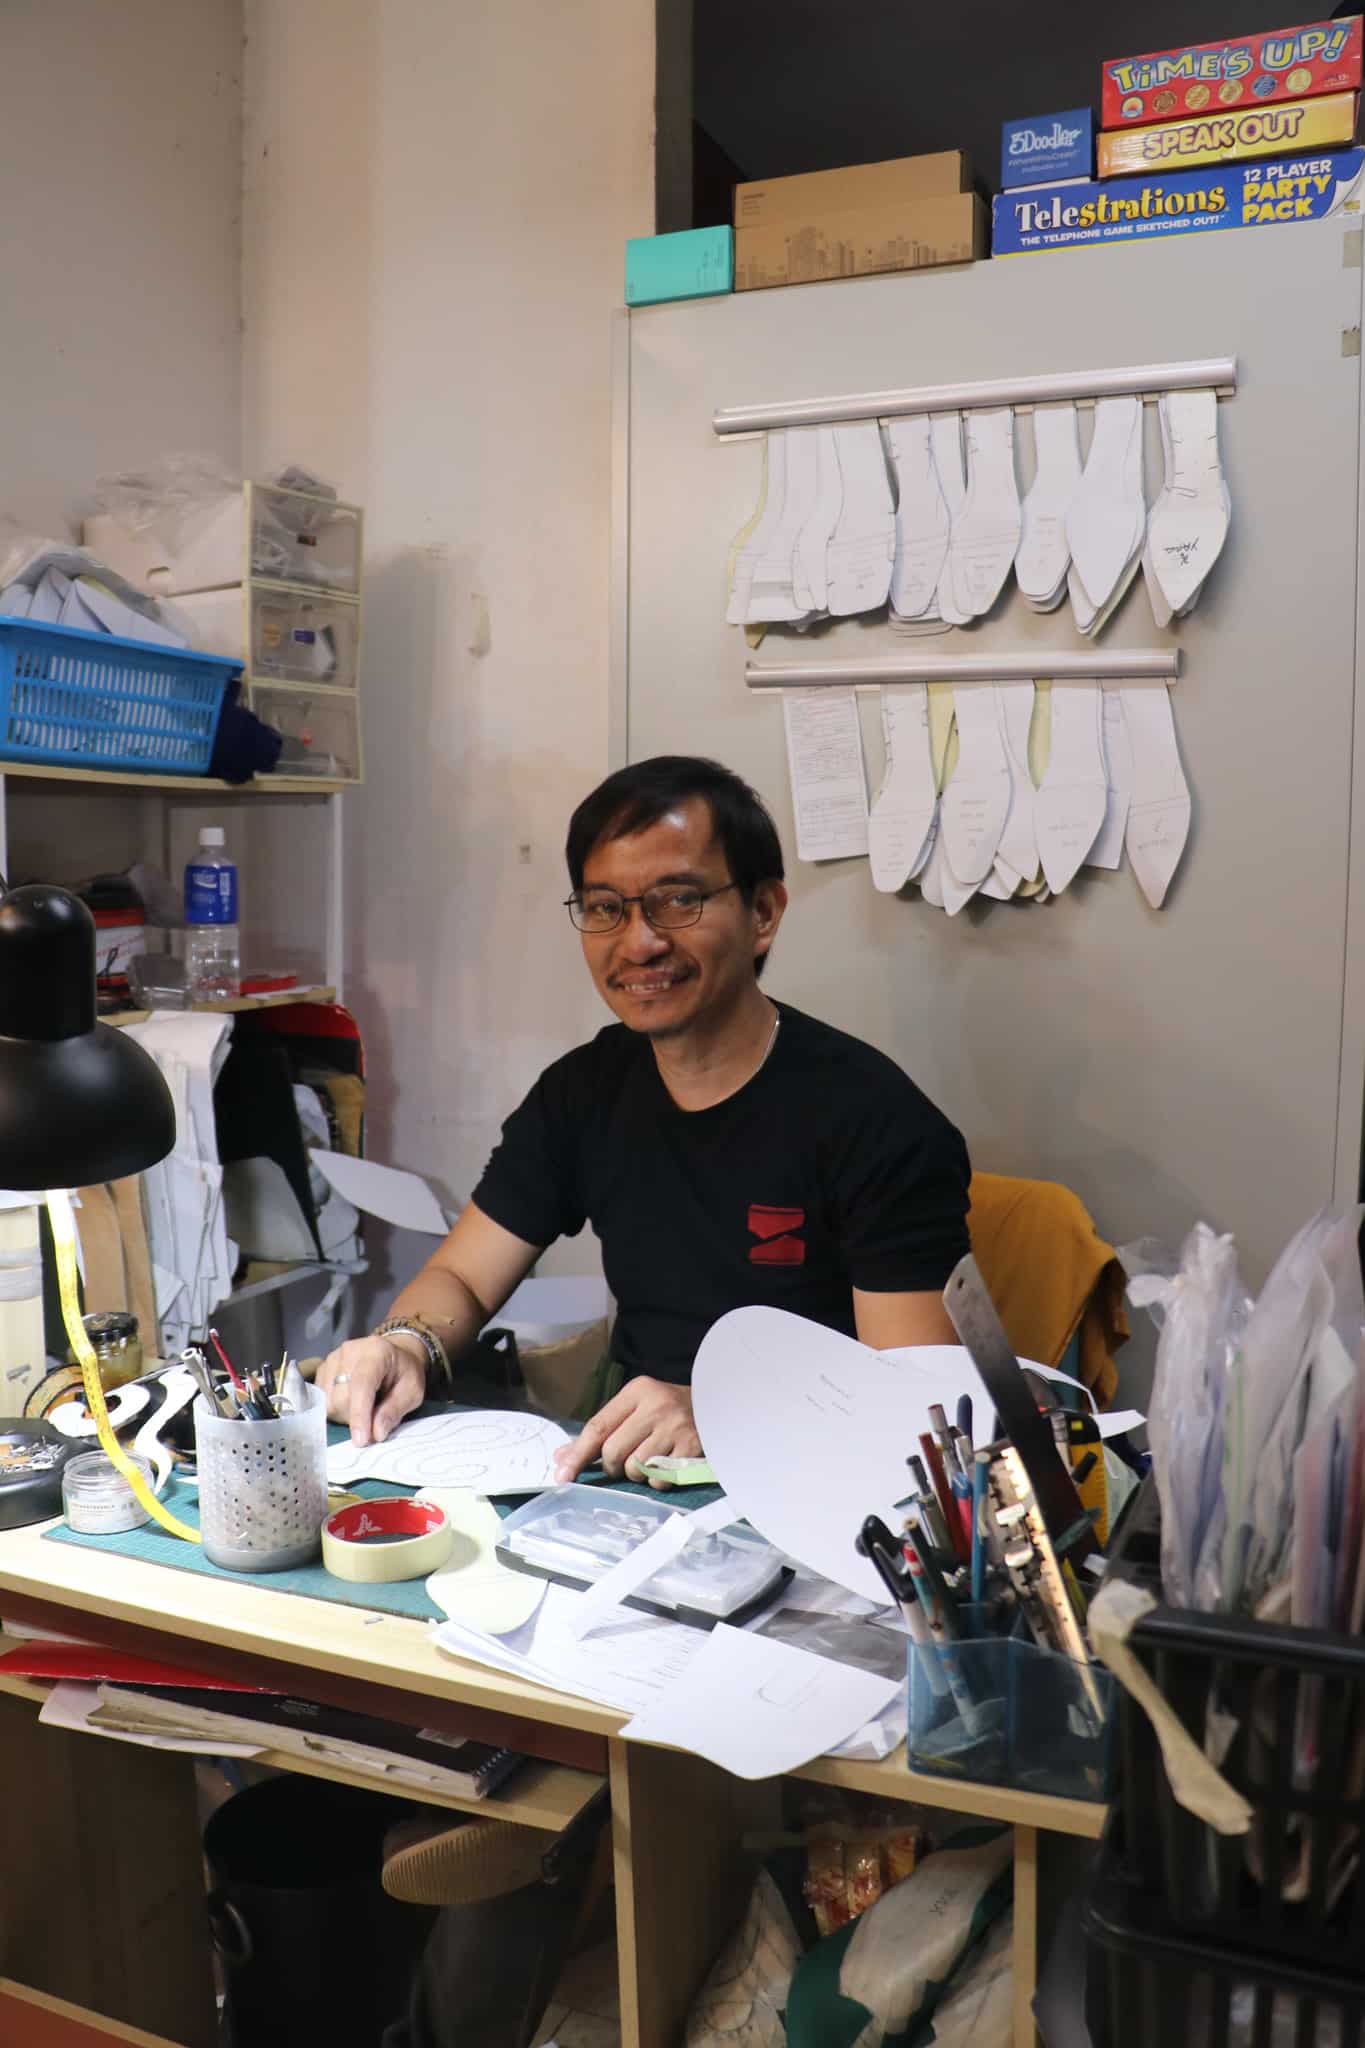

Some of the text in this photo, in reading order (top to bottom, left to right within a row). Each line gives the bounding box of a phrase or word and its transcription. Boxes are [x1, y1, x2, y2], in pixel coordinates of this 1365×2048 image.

[1261, 25, 1349, 71] UP!
[1143, 108, 1305, 160] SPEAK OUT
[1244, 159, 1332, 182] 12 PLAYER
[1243, 174, 1332, 203] PARTY
[1014, 186, 1227, 233] Telestrations
[1242, 197, 1313, 224] PACK
[1020, 236, 1042, 247] THE
[1044, 229, 1101, 243] TELEPHONE
[1103, 225, 1134, 237] GAME
[1135, 218, 1191, 232] SKETCHED
